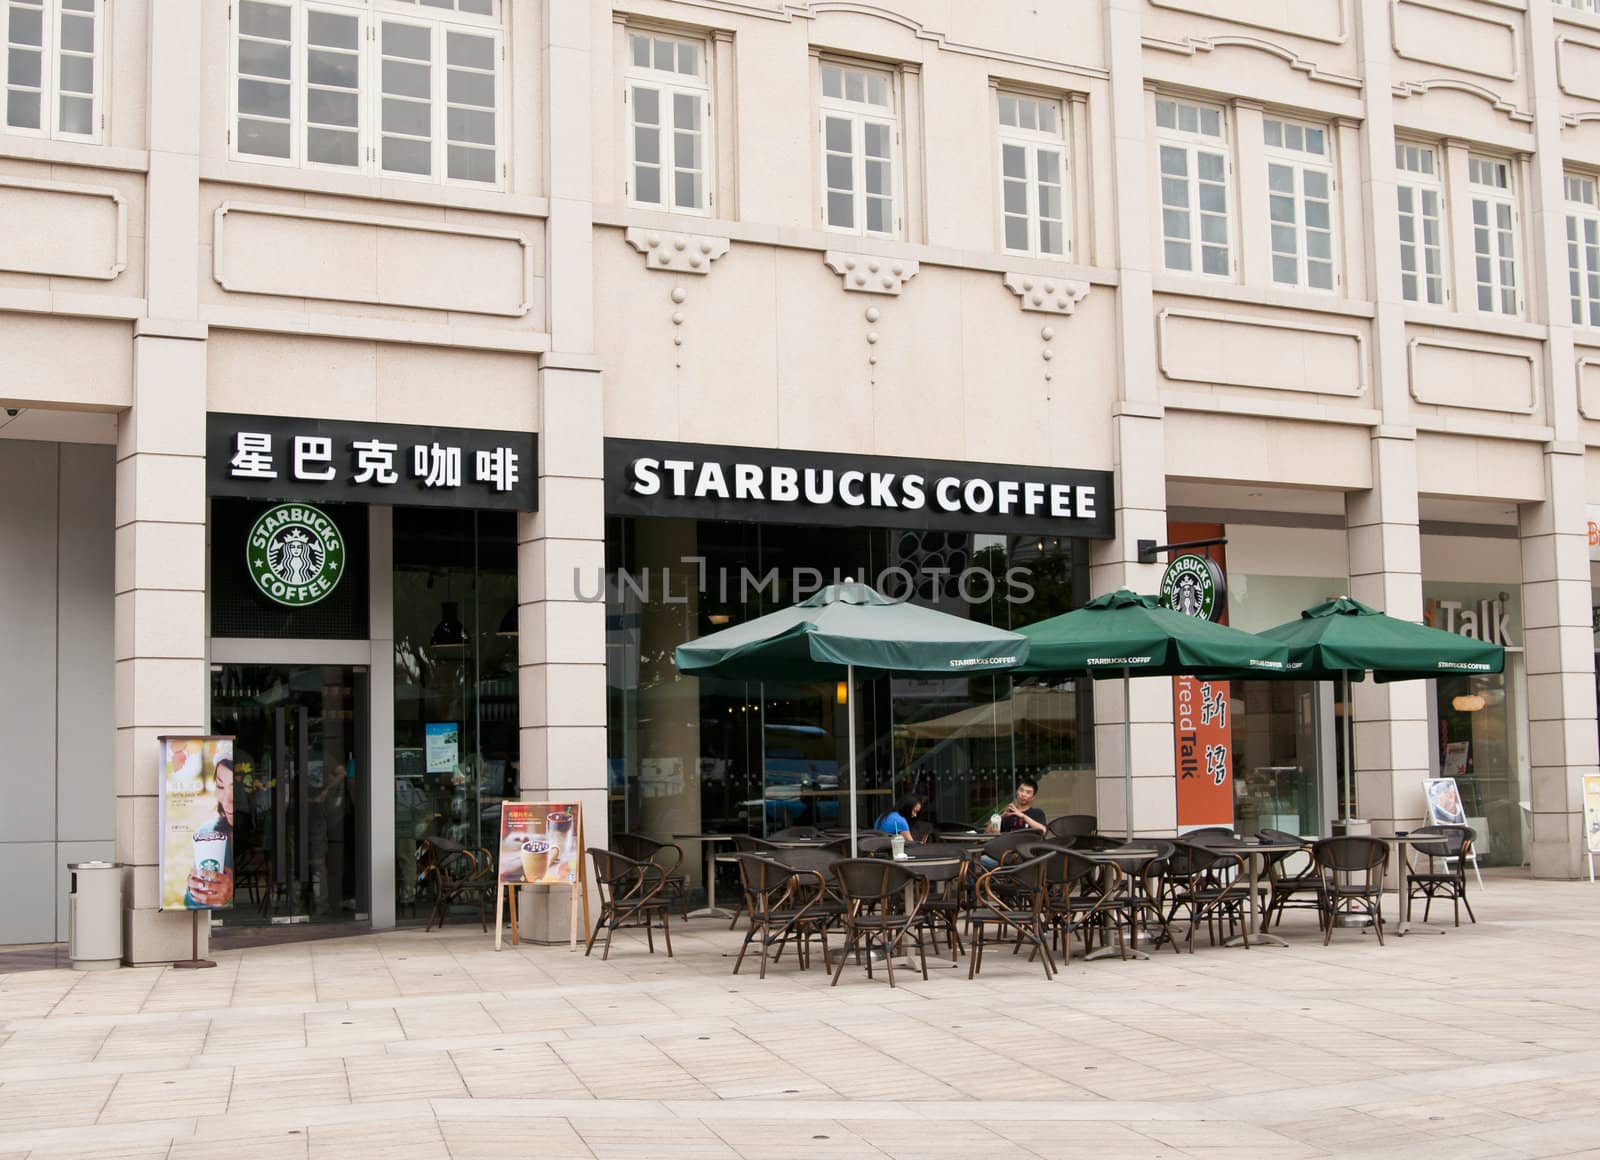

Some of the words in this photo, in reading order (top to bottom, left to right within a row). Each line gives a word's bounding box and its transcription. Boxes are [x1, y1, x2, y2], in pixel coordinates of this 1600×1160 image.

[231, 431, 519, 491] 星巴克咖啡
[634, 457, 926, 510] STARBUCKS
[936, 476, 1096, 519] COFFEE
[252, 508, 340, 551] STARBUCKS
[260, 572, 331, 601] COFFEE
[1163, 558, 1211, 595] STARBUCKS
